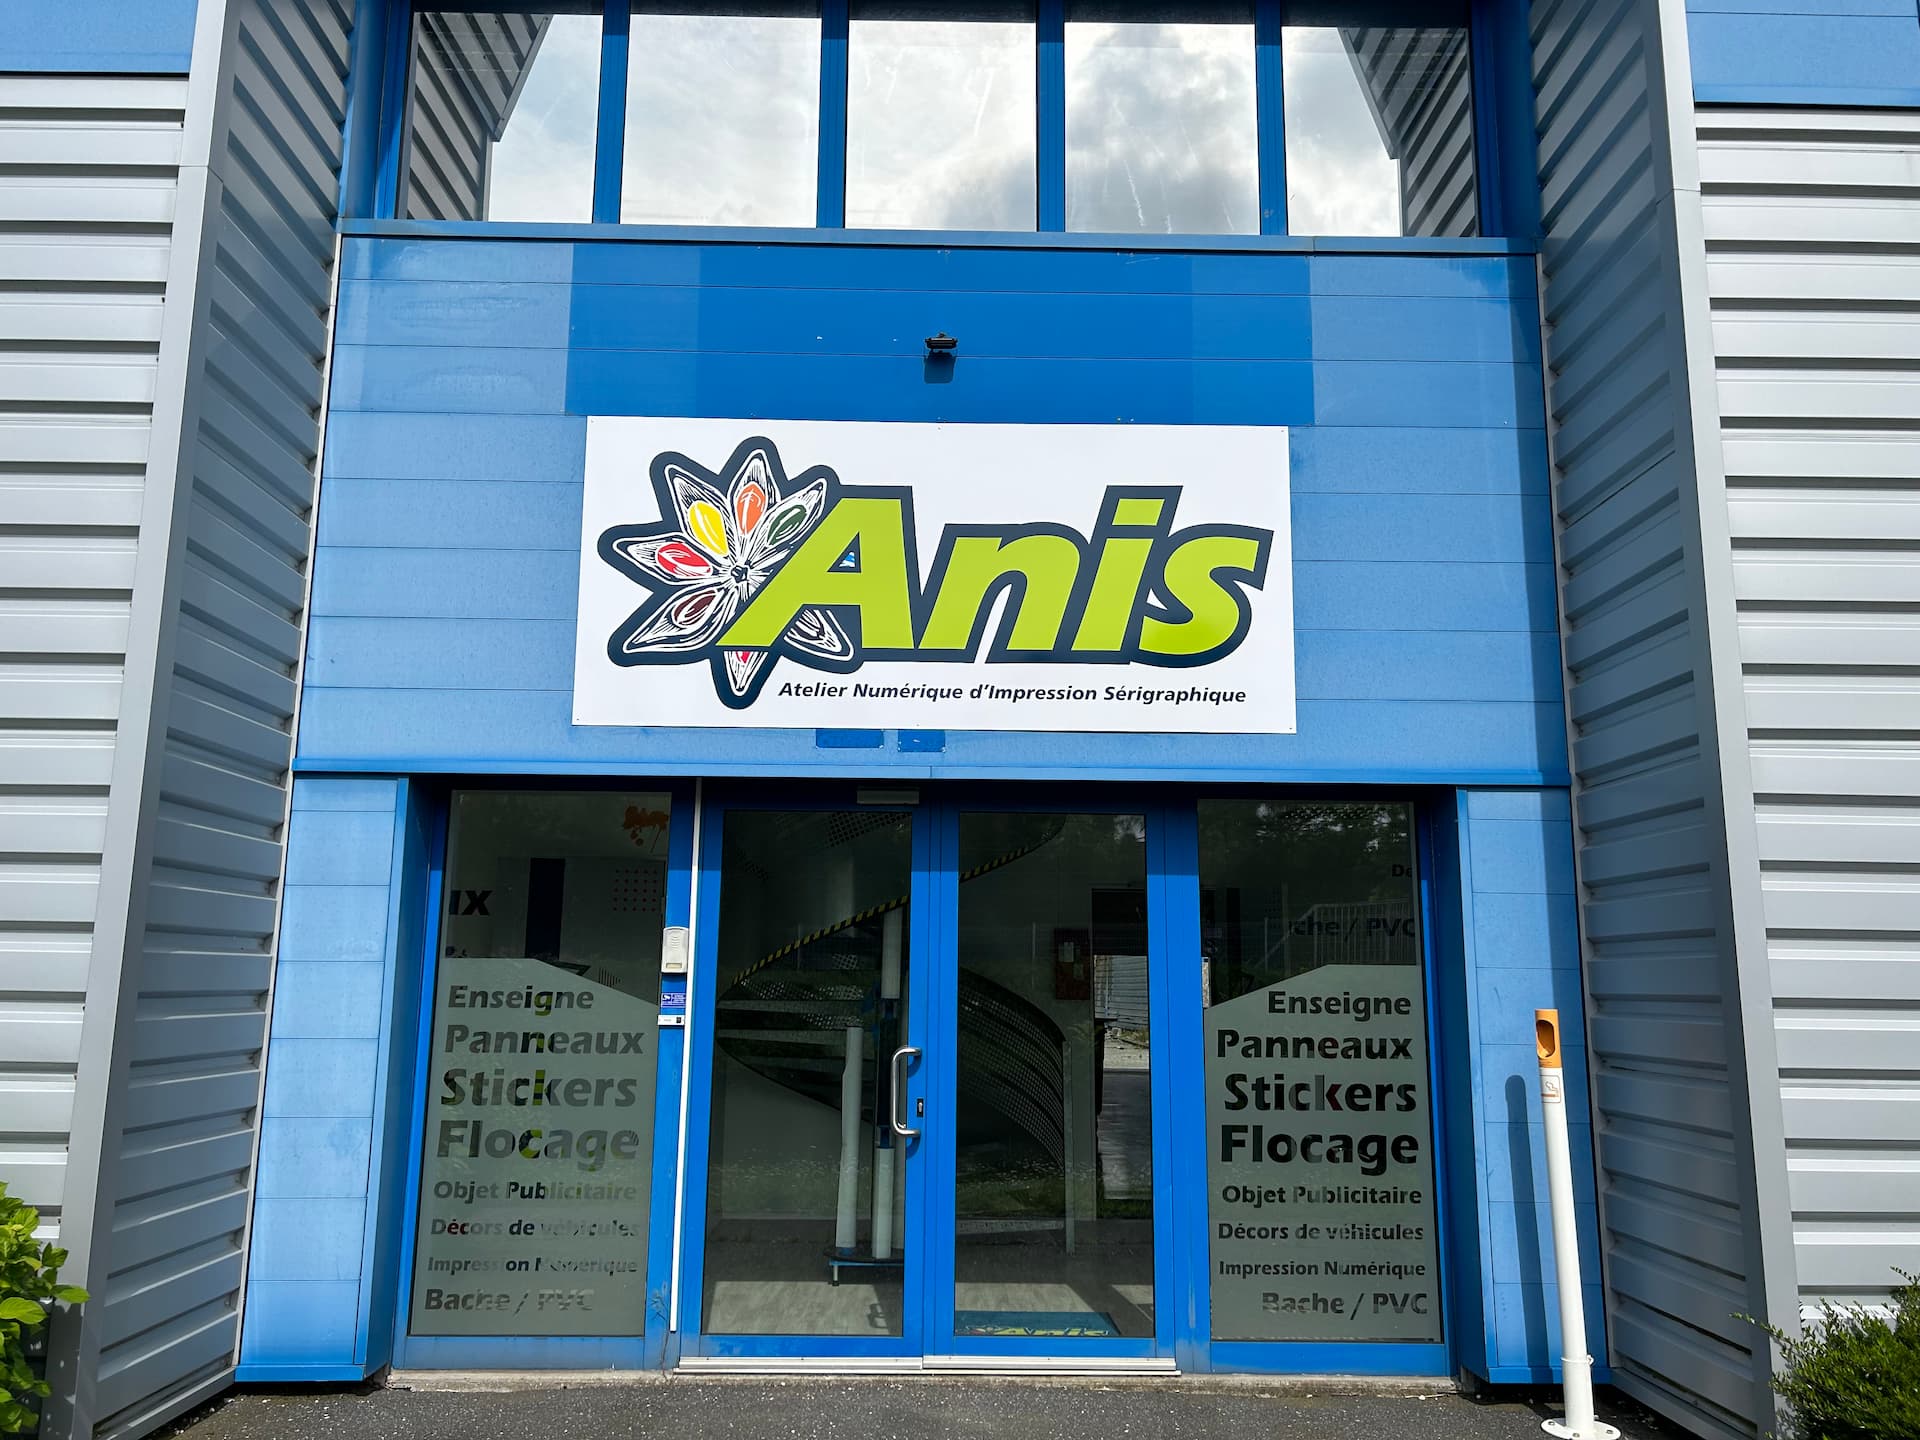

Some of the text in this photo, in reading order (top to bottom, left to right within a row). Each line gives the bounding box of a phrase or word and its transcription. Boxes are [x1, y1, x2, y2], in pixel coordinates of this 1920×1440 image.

[714, 492, 1264, 658] Anis
[778, 682, 1247, 705] Atelier Numérique d'Impression Sérigraphique
[447, 985, 595, 1017] Enseigne
[1268, 991, 1412, 1022] Enseigne
[445, 1024, 645, 1055] Panneaux
[1217, 1029, 1413, 1060] Panneaux
[440, 1069, 638, 1107] Stickers
[1224, 1073, 1417, 1112] Stickers
[437, 1120, 640, 1172] Flocage
[1221, 1125, 1419, 1176] Flocage
[433, 1181, 637, 1204] Objet Publicitaire
[1222, 1185, 1422, 1208] Objet Publicitaire
[430, 1217, 505, 1236] Décors
[508, 1218, 535, 1236] de
[1218, 1223, 1424, 1240] Décors de véhicules
[427, 1256, 529, 1275] Impresson
[1218, 1260, 1426, 1280] Impression Numérique
[1262, 1292, 1428, 1320] Bache / PVC
